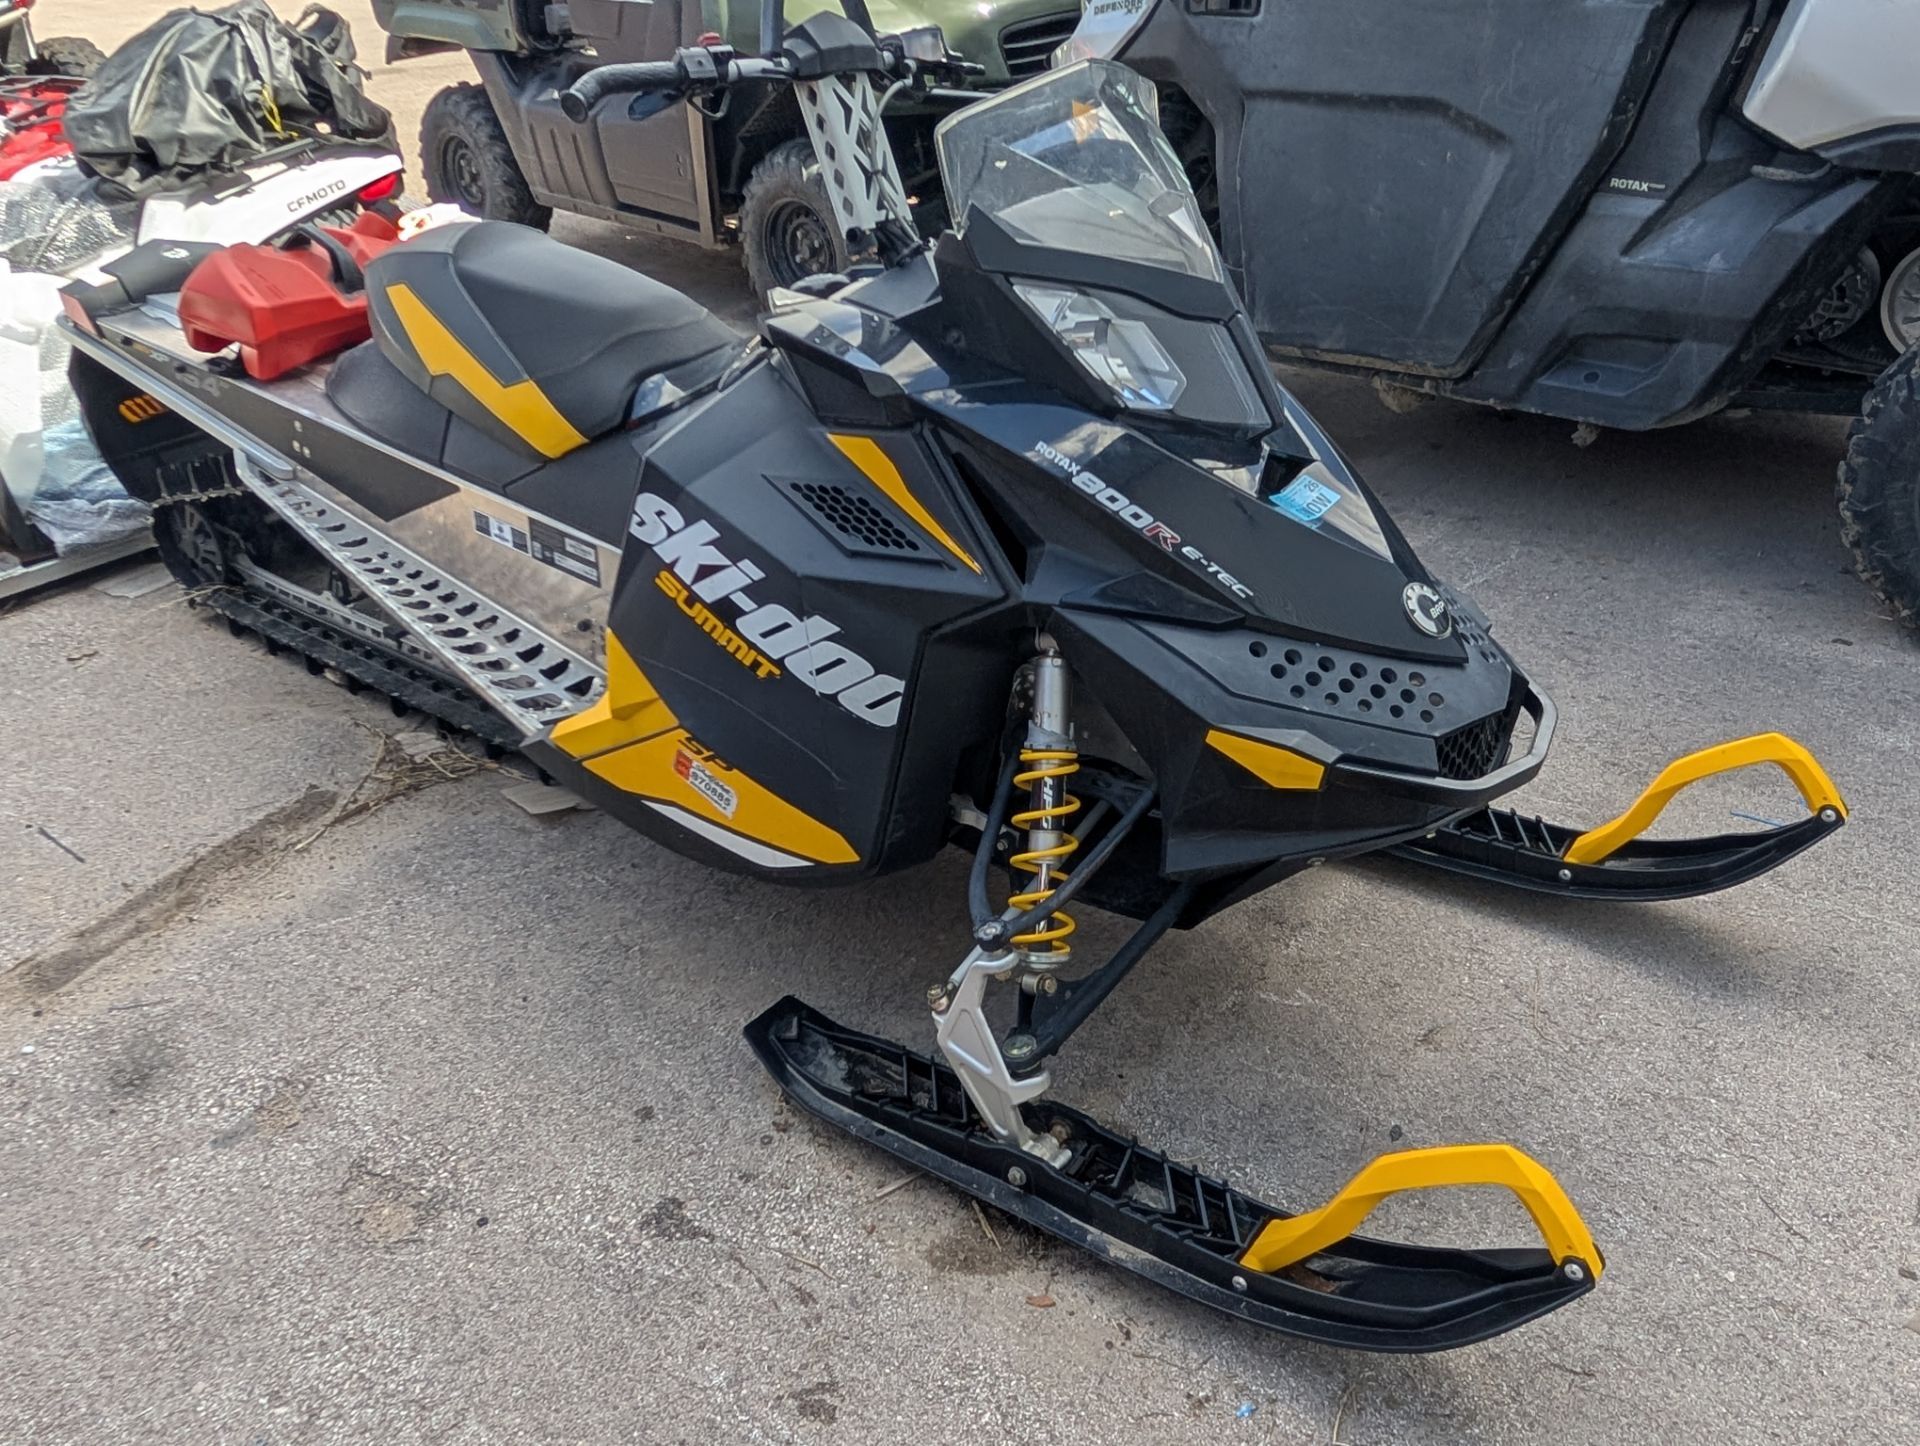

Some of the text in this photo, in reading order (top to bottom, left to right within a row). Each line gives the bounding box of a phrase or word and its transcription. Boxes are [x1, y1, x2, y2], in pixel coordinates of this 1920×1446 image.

[1094, 0, 1143, 16] DEFENDER
[286, 179, 347, 213] CFMOTO
[1610, 177, 1649, 192] ROTAX
[1034, 440, 1082, 476] ROTAX
[1181, 545, 1254, 599] E-TEC
[1429, 600, 1445, 619] BRP
[654, 570, 783, 680] SUMMIT
